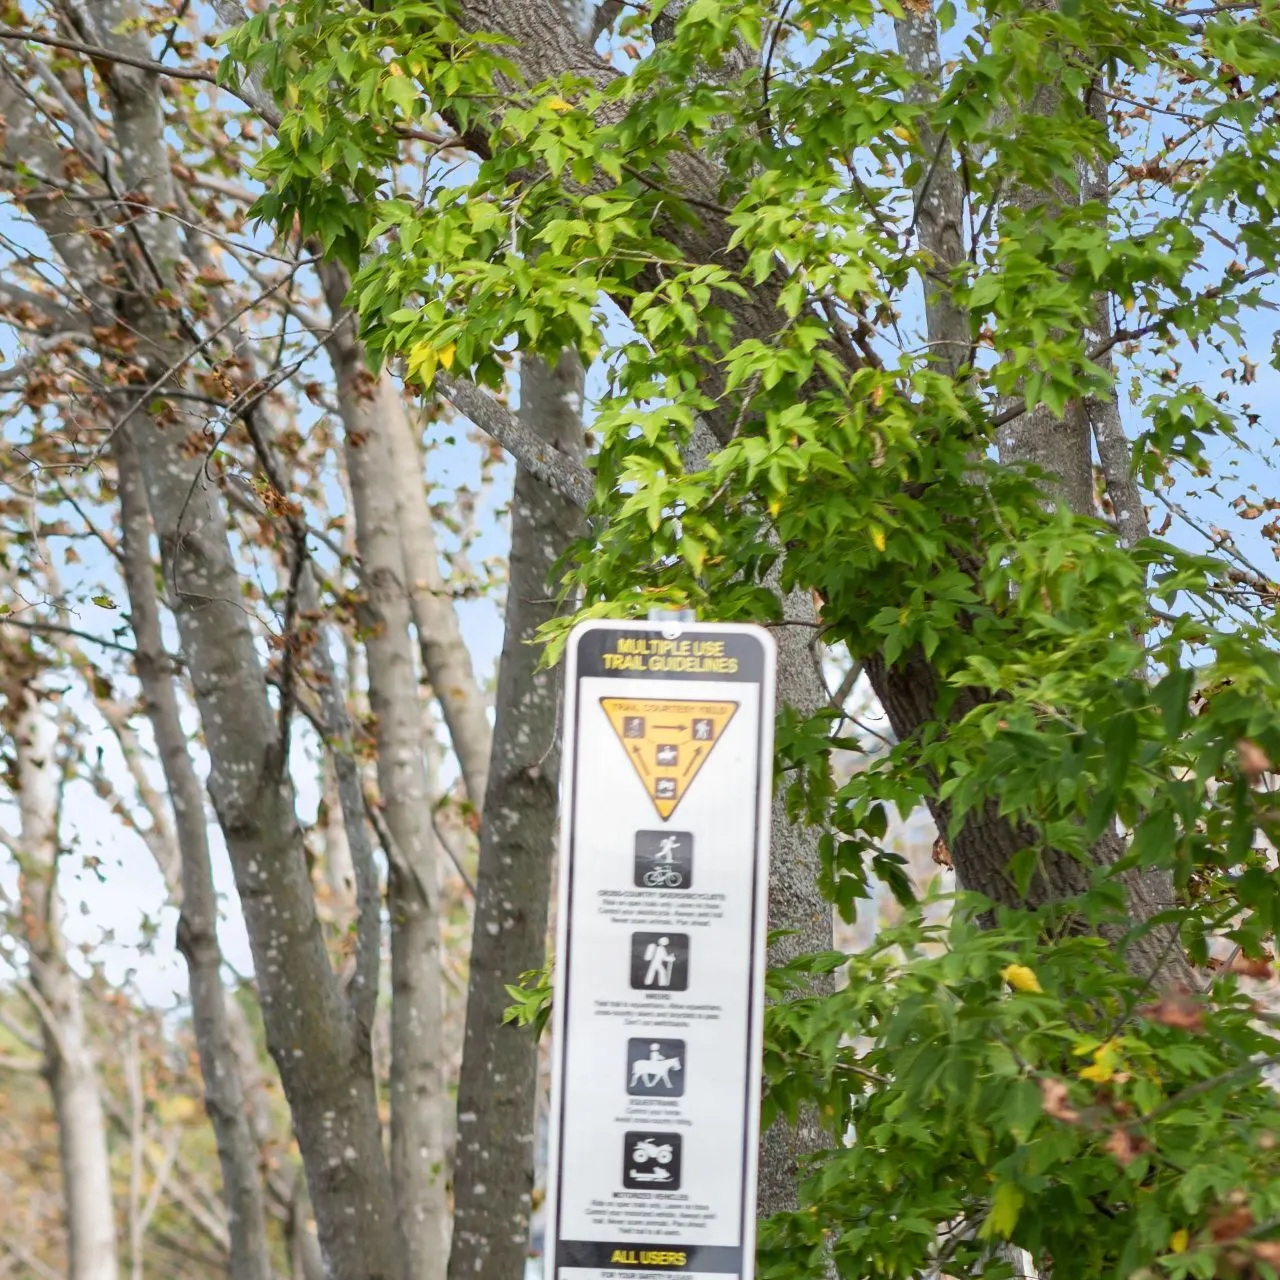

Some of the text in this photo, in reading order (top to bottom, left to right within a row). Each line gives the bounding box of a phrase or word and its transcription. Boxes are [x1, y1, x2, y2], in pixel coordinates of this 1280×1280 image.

[617, 638, 725, 656] MULTIPLE USE
[602, 653, 738, 673] TRAIL GUIDELINES
[611, 1250, 687, 1266] ALL USERS
